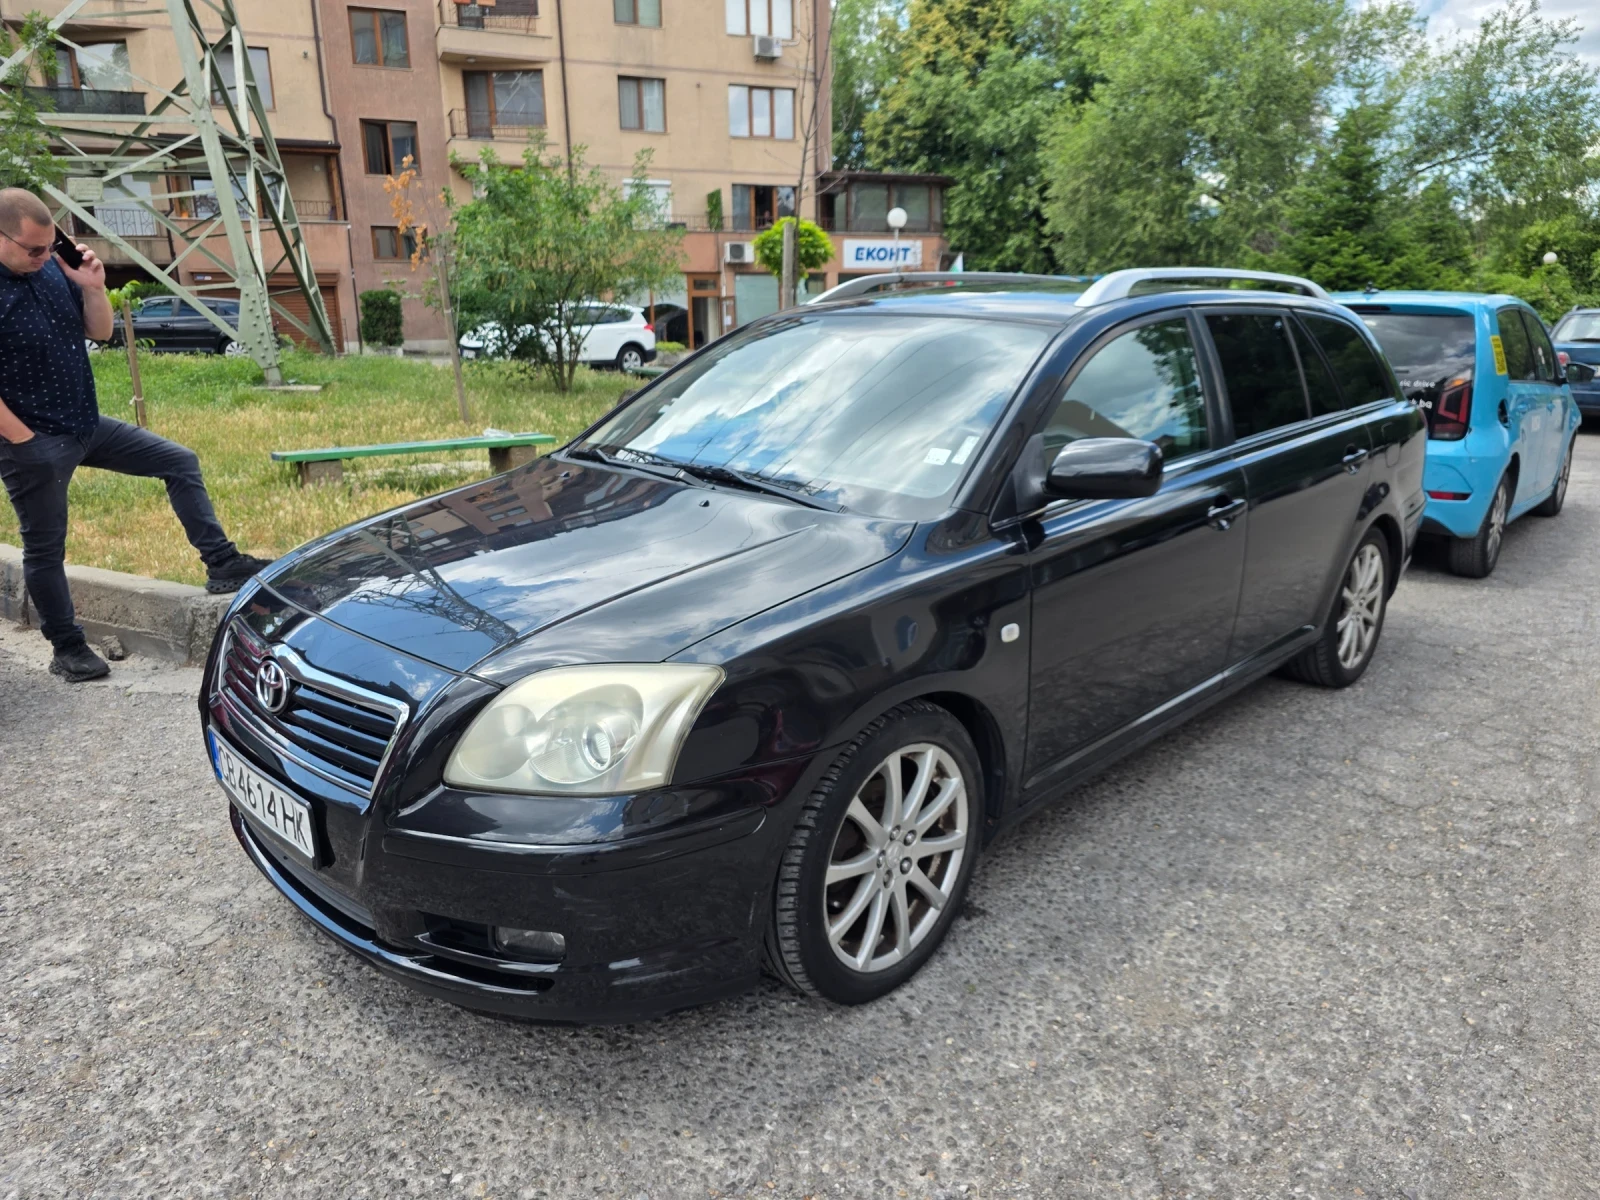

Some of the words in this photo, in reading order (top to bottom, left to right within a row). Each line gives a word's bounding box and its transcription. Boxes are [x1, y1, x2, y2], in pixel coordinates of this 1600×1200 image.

[855, 247, 911, 261] ЕКОНТ
[1413, 379, 1436, 388] drive
[218, 745, 237, 790] CB
[238, 766, 279, 828] 4614
[280, 795, 309, 850] HK
